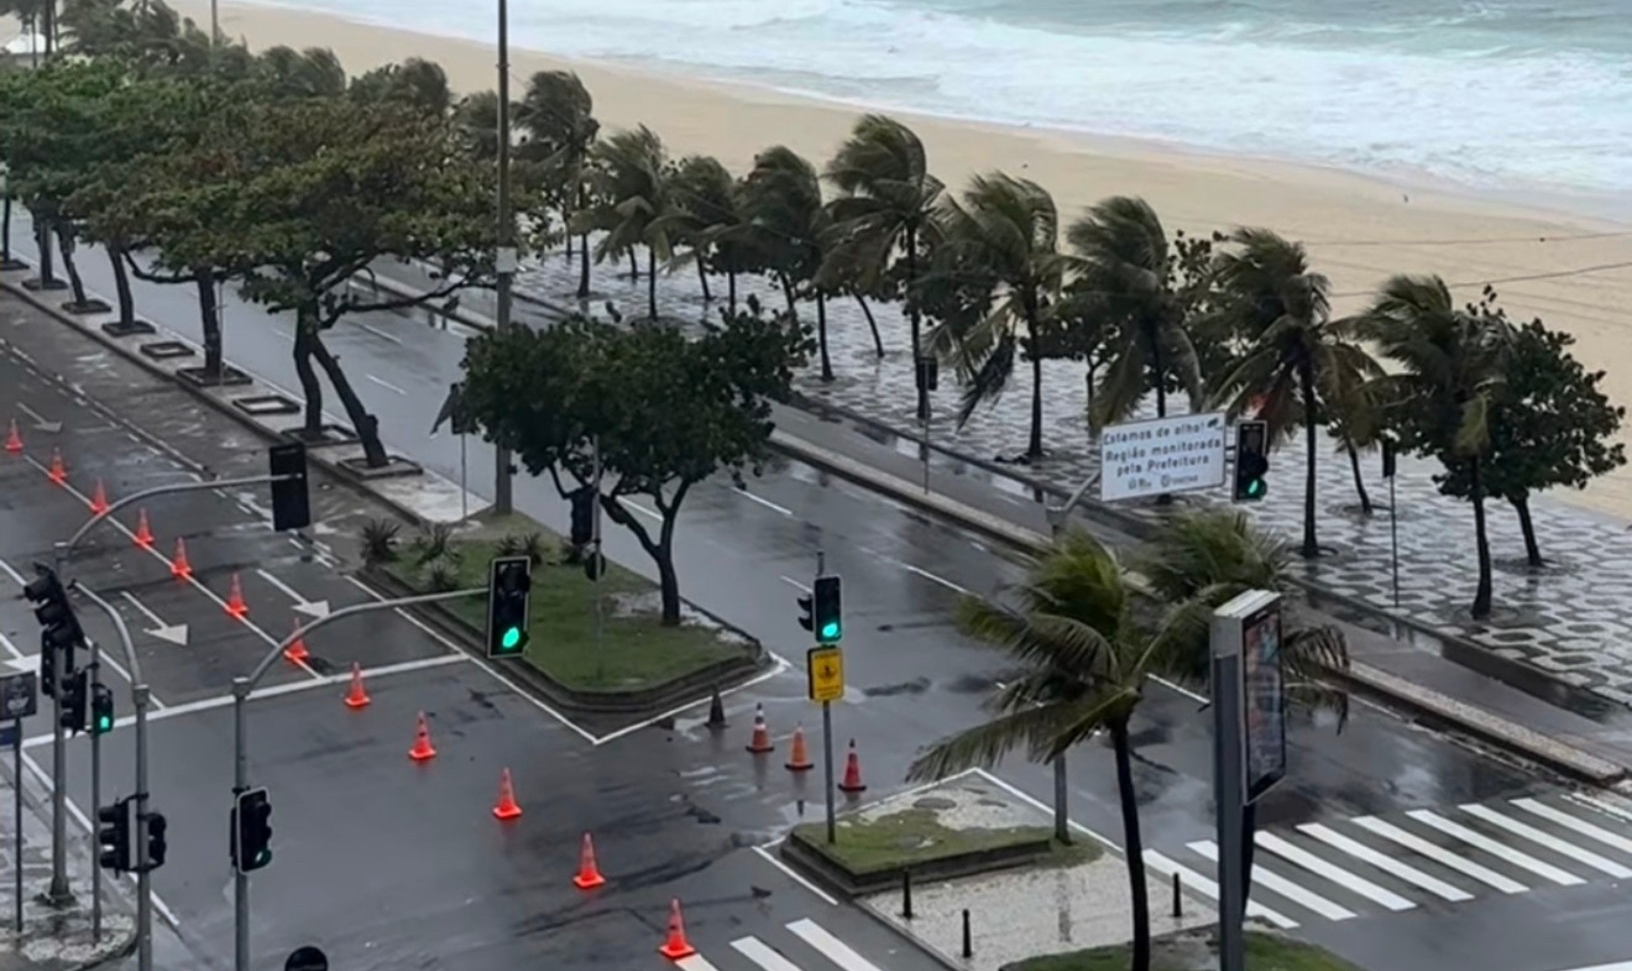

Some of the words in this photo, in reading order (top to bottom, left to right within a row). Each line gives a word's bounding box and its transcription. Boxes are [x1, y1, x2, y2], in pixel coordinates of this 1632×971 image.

[1103, 430, 1152, 445] Estamos
[1156, 427, 1170, 438] de
[1106, 447, 1146, 462] Região
[1151, 439, 1221, 455] monitorada
[1117, 463, 1142, 478] pela
[1148, 455, 1209, 471] Prefeitura
